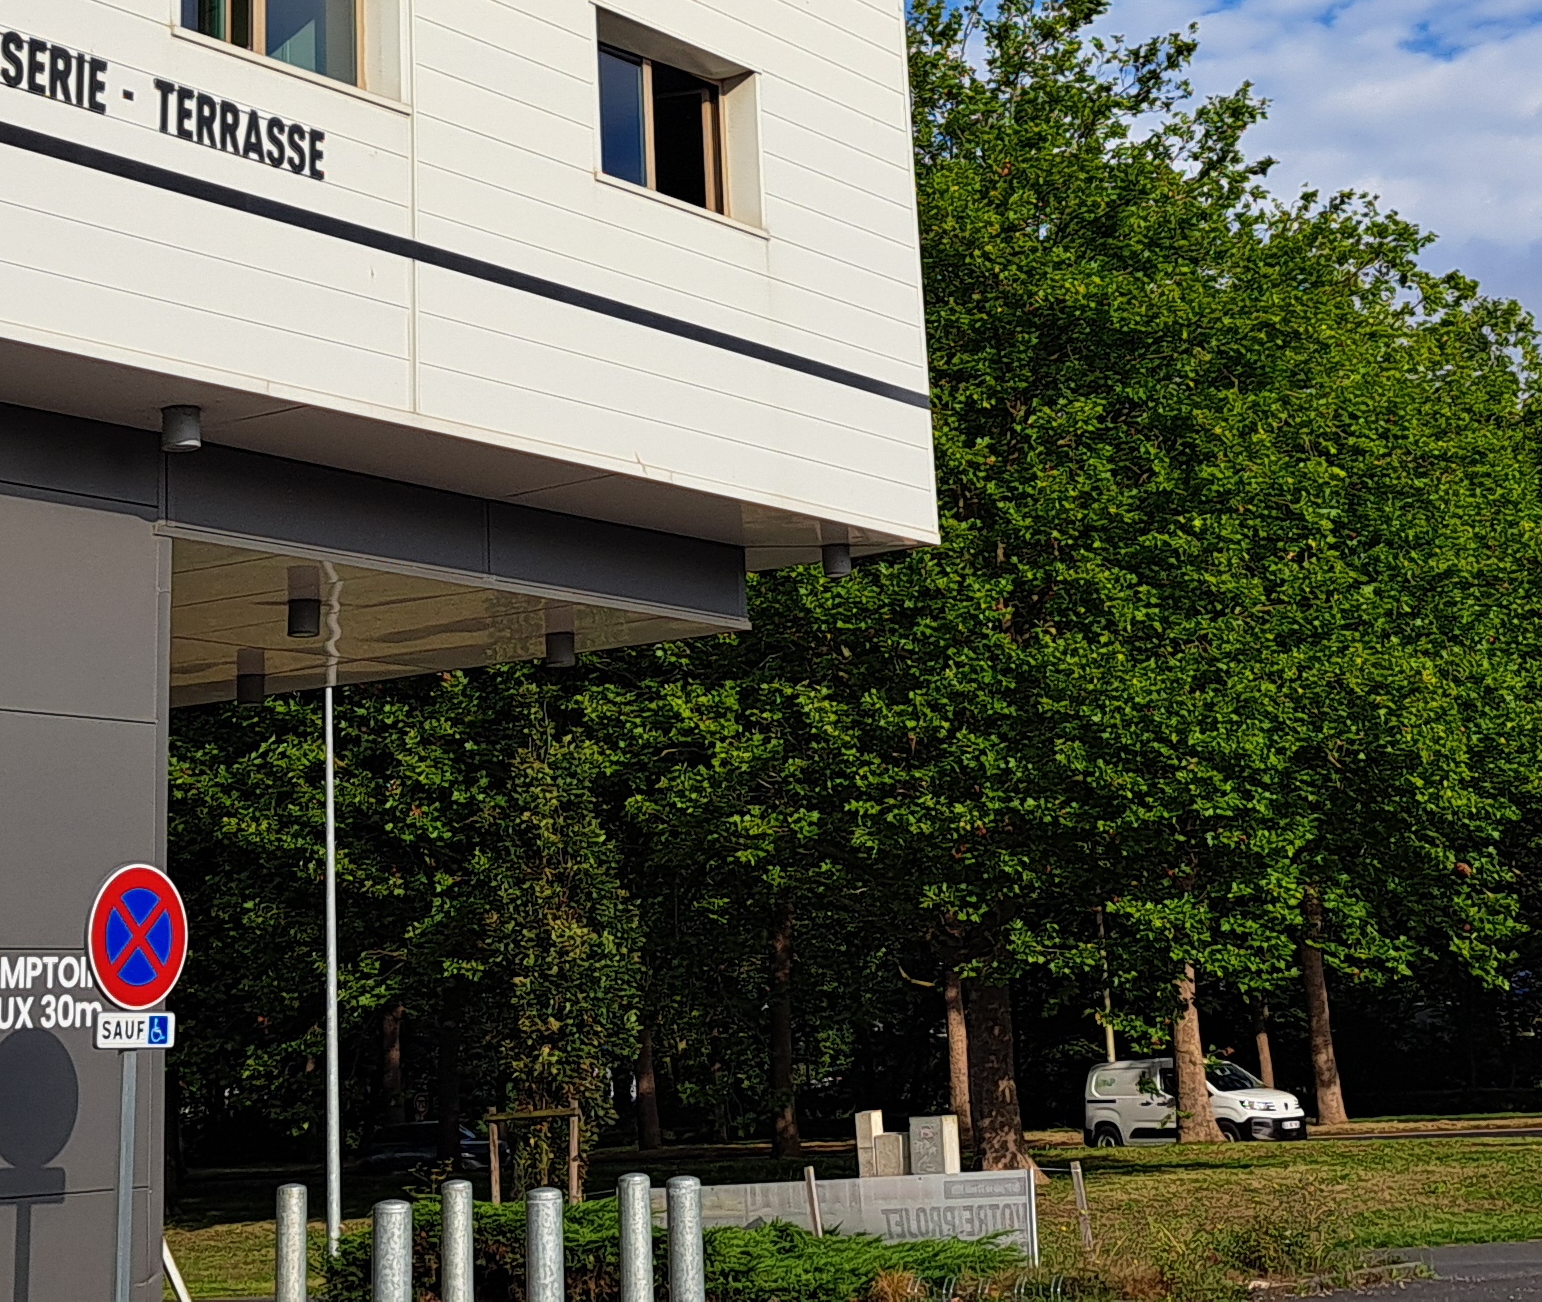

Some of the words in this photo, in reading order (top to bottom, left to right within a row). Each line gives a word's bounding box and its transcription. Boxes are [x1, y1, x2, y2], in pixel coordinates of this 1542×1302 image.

[153, 77, 326, 182] TERRASSE
[40, 994, 103, 1029] 30m
[101, 1019, 146, 1040] SAUF
